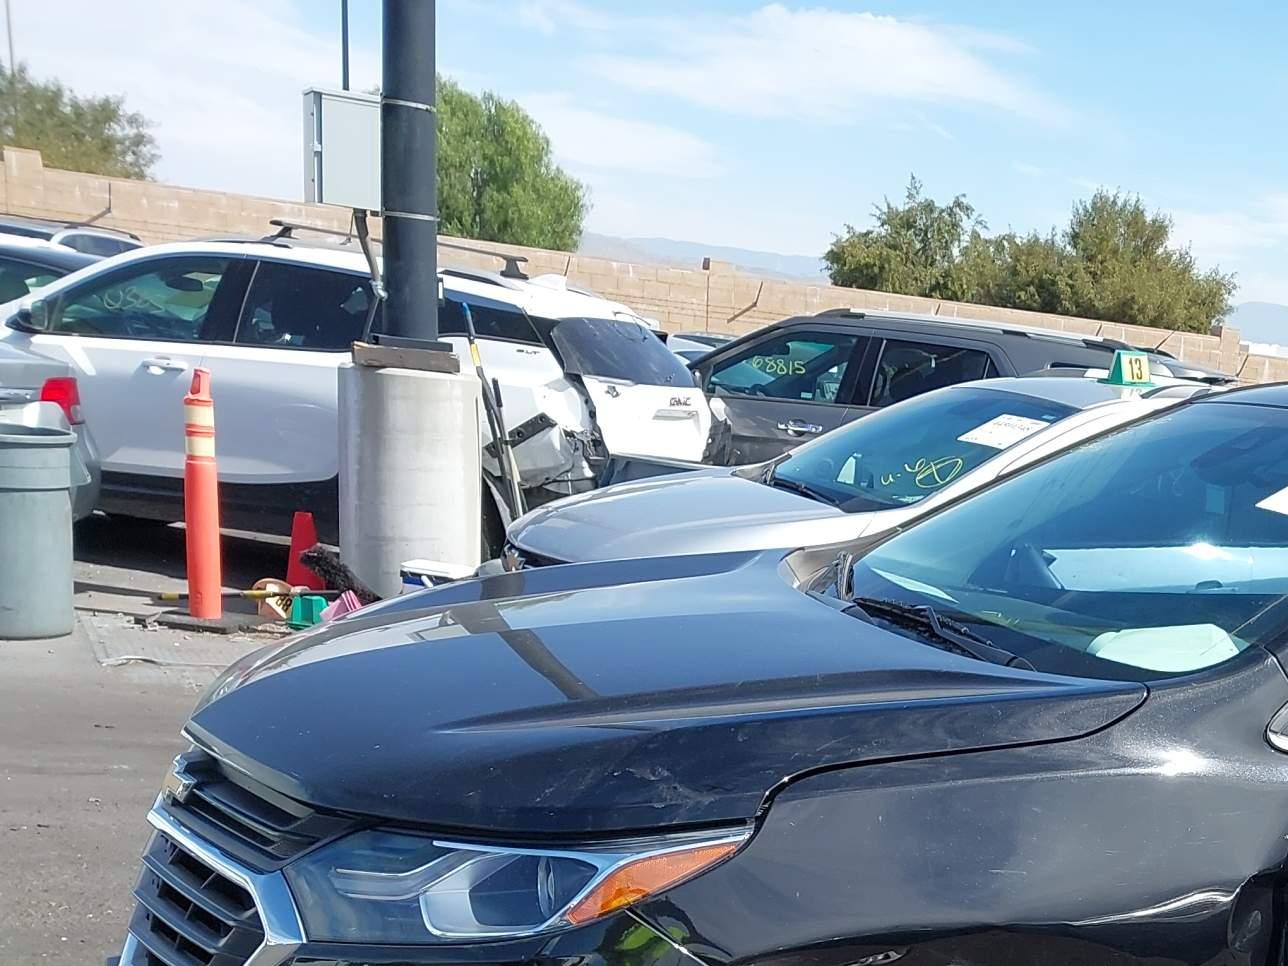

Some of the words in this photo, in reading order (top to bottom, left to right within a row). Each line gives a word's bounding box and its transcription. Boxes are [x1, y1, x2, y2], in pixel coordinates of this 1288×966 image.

[752, 355, 806, 375] 68815
[1128, 357, 1143, 381] 13
[669, 397, 692, 407] GMC
